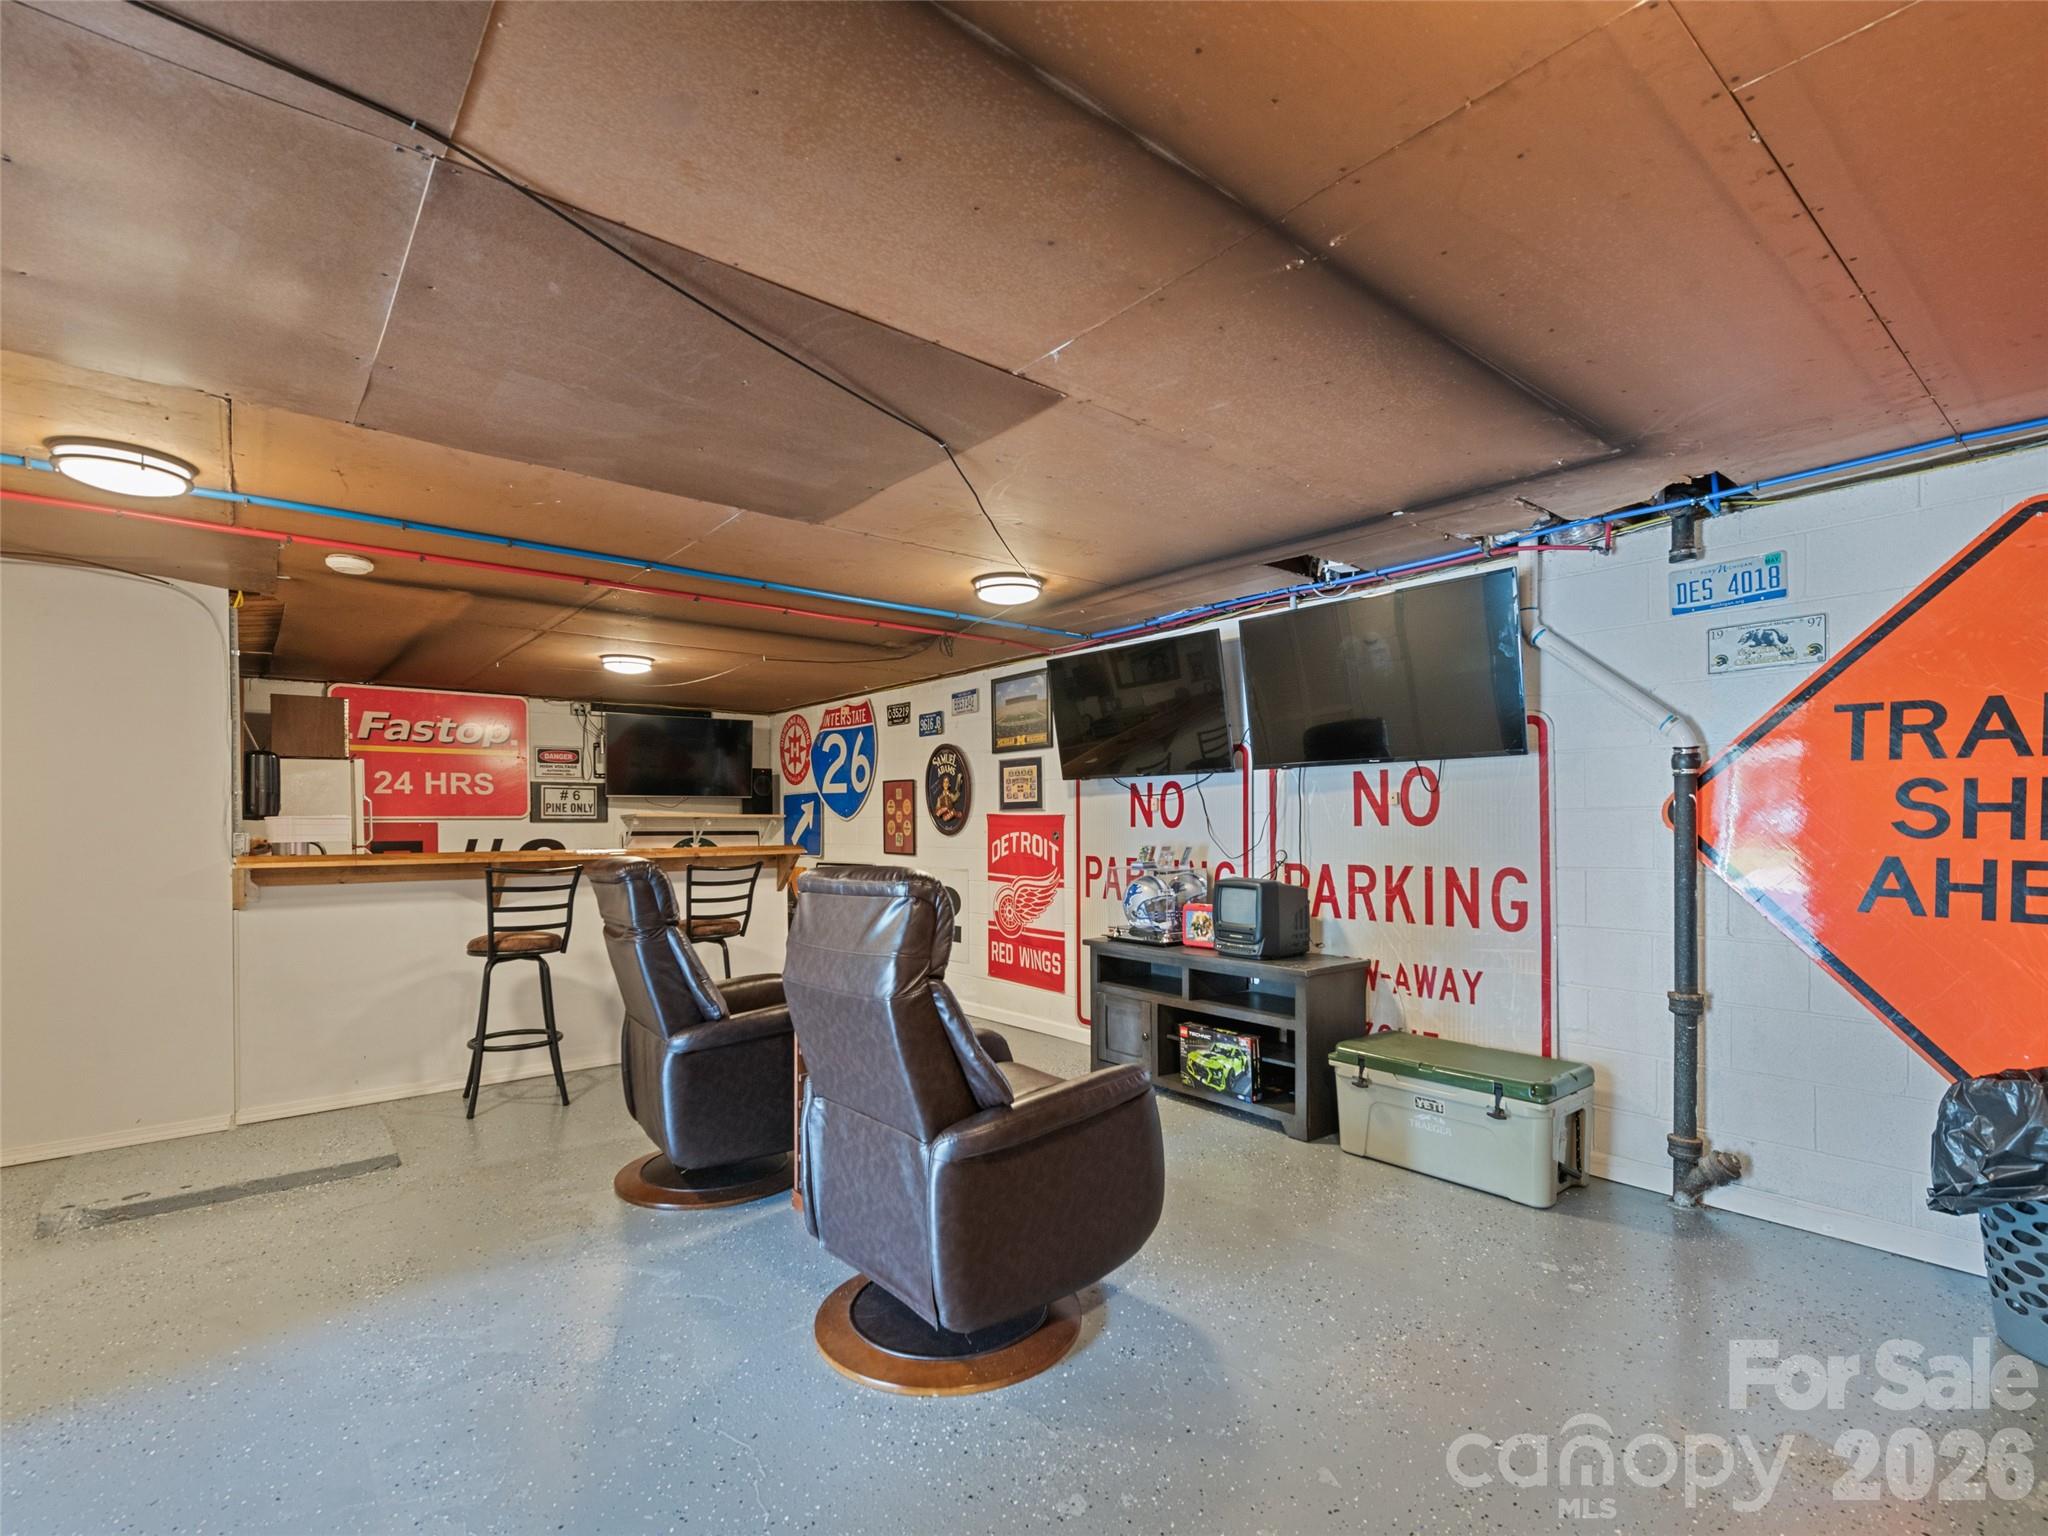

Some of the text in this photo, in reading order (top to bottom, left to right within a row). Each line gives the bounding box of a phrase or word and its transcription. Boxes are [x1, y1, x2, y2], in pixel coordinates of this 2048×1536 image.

[1677, 565, 1780, 605] DES 4018
[1711, 616, 1823, 641] 19 97
[822, 708, 866, 728] INTERSTATE
[543, 752, 574, 760] DANGER
[822, 731, 870, 793] 26
[932, 753, 957, 767] SAMUEL
[937, 764, 956, 777] ADAMS
[373, 771, 495, 795] 24 HRS
[545, 802, 594, 813] PINE ONLY
[573, 790, 581, 801] 6
[1130, 781, 1184, 828] NO
[1353, 766, 1440, 827] NO
[992, 832, 1059, 867] DETROIT
[991, 941, 1061, 975] RED WINGS
[1416, 1097, 1444, 1114] YETI
